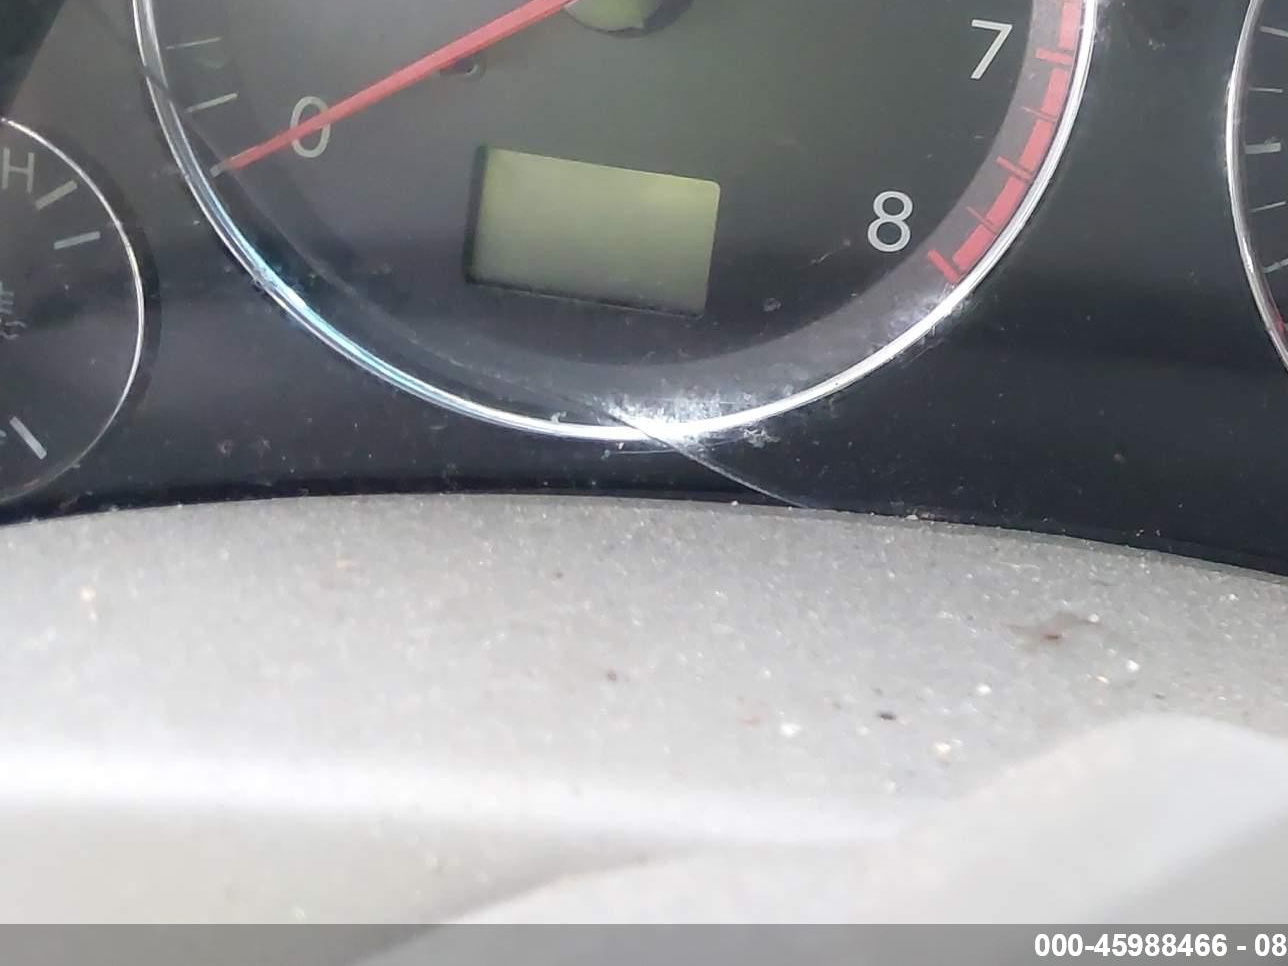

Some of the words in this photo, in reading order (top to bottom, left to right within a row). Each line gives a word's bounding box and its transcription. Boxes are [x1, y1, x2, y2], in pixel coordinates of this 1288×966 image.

[970, 18, 1013, 80] 7
[289, 95, 332, 159] 0
[866, 190, 914, 253] 8
